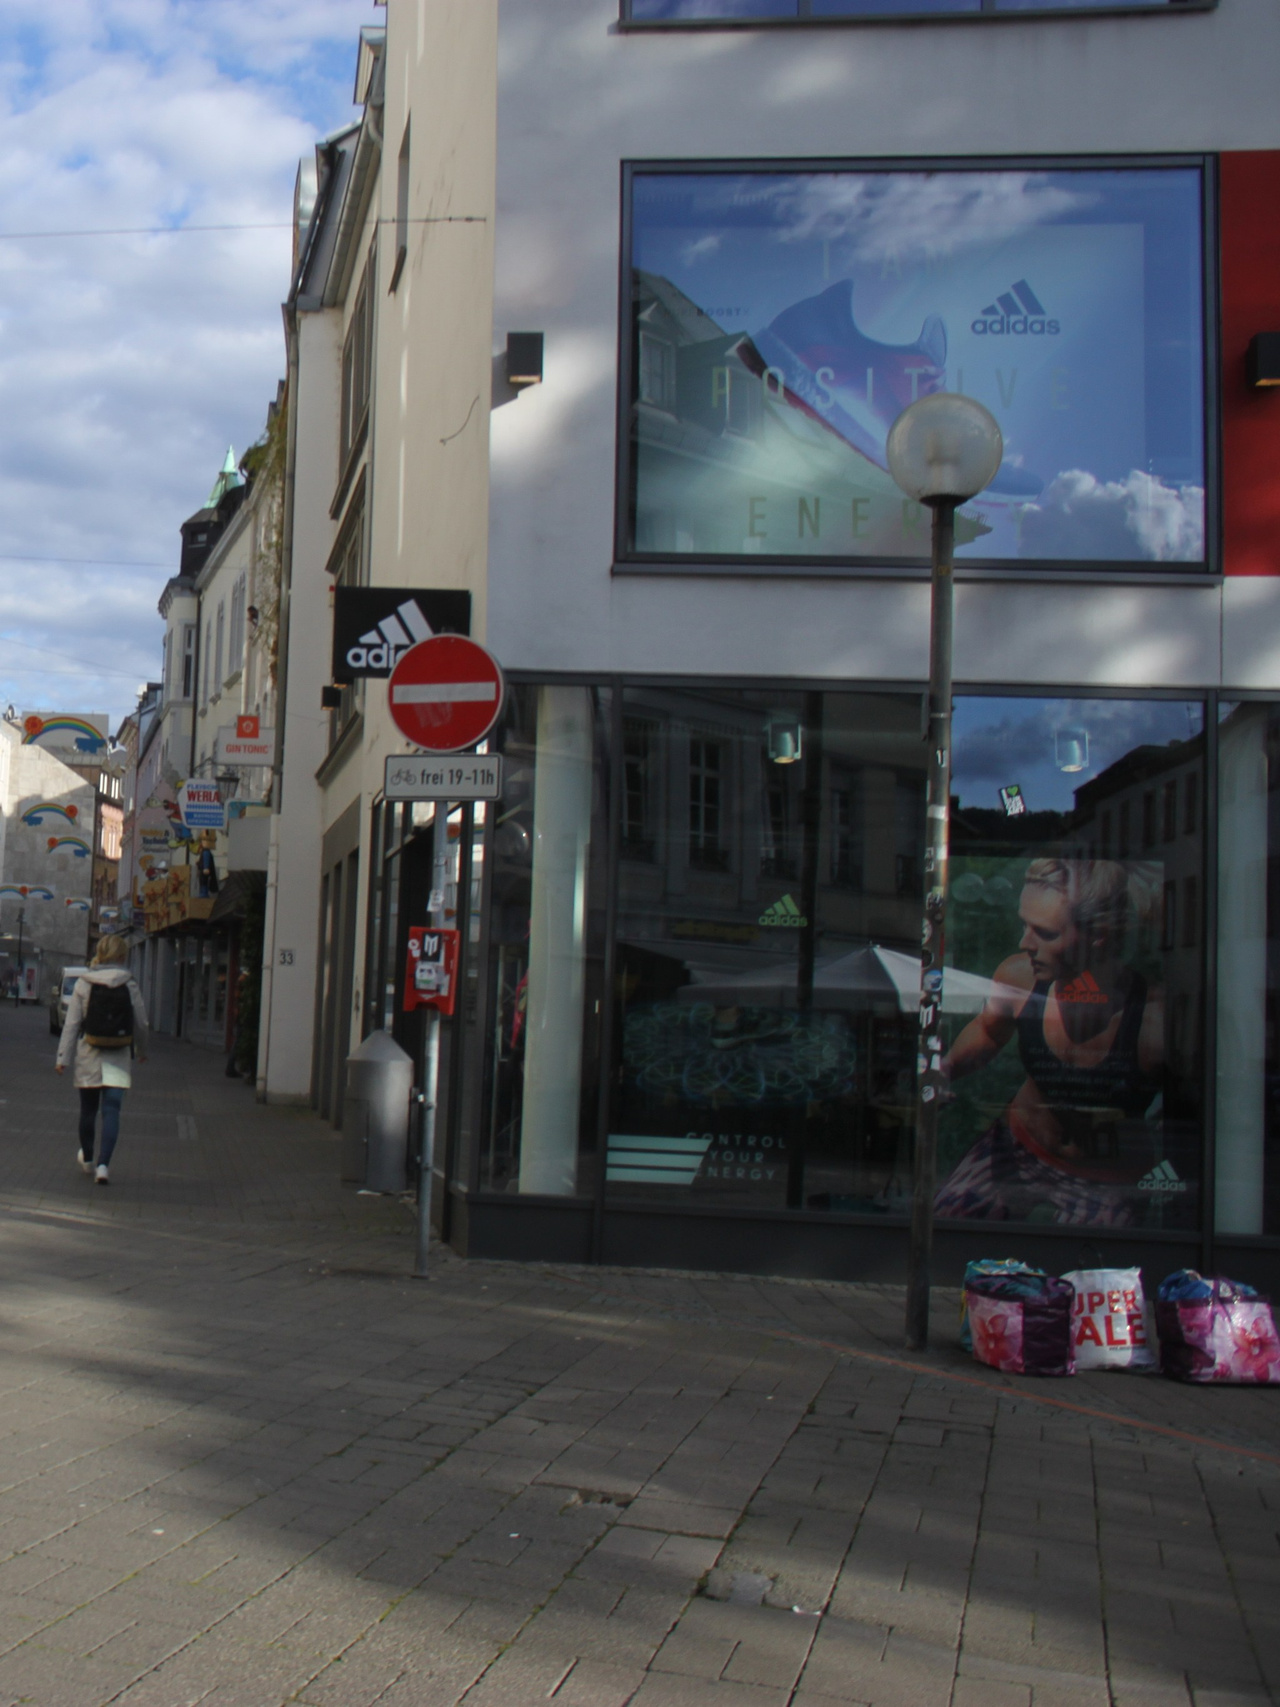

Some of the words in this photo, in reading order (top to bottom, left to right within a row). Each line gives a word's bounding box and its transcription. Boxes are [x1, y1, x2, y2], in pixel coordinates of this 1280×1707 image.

[971, 314, 1060, 335] adidas
[711, 367, 1070, 410] POSITIVE
[748, 496, 1026, 540] ENERY
[346, 642, 406, 669] adi
[226, 744, 241, 754] GIN
[243, 744, 268, 754] TONIC
[420, 768, 444, 785] frei
[187, 791, 221, 802] WERLA
[758, 914, 808, 928] adidas
[280, 952, 294, 965] 33
[1056, 990, 1108, 1004] adidas
[709, 1150, 765, 1164] YOUR
[1137, 1180, 1187, 1192] adidas
[1075, 1290, 1140, 1316] UPER
[1076, 1314, 1147, 1347] ALE
